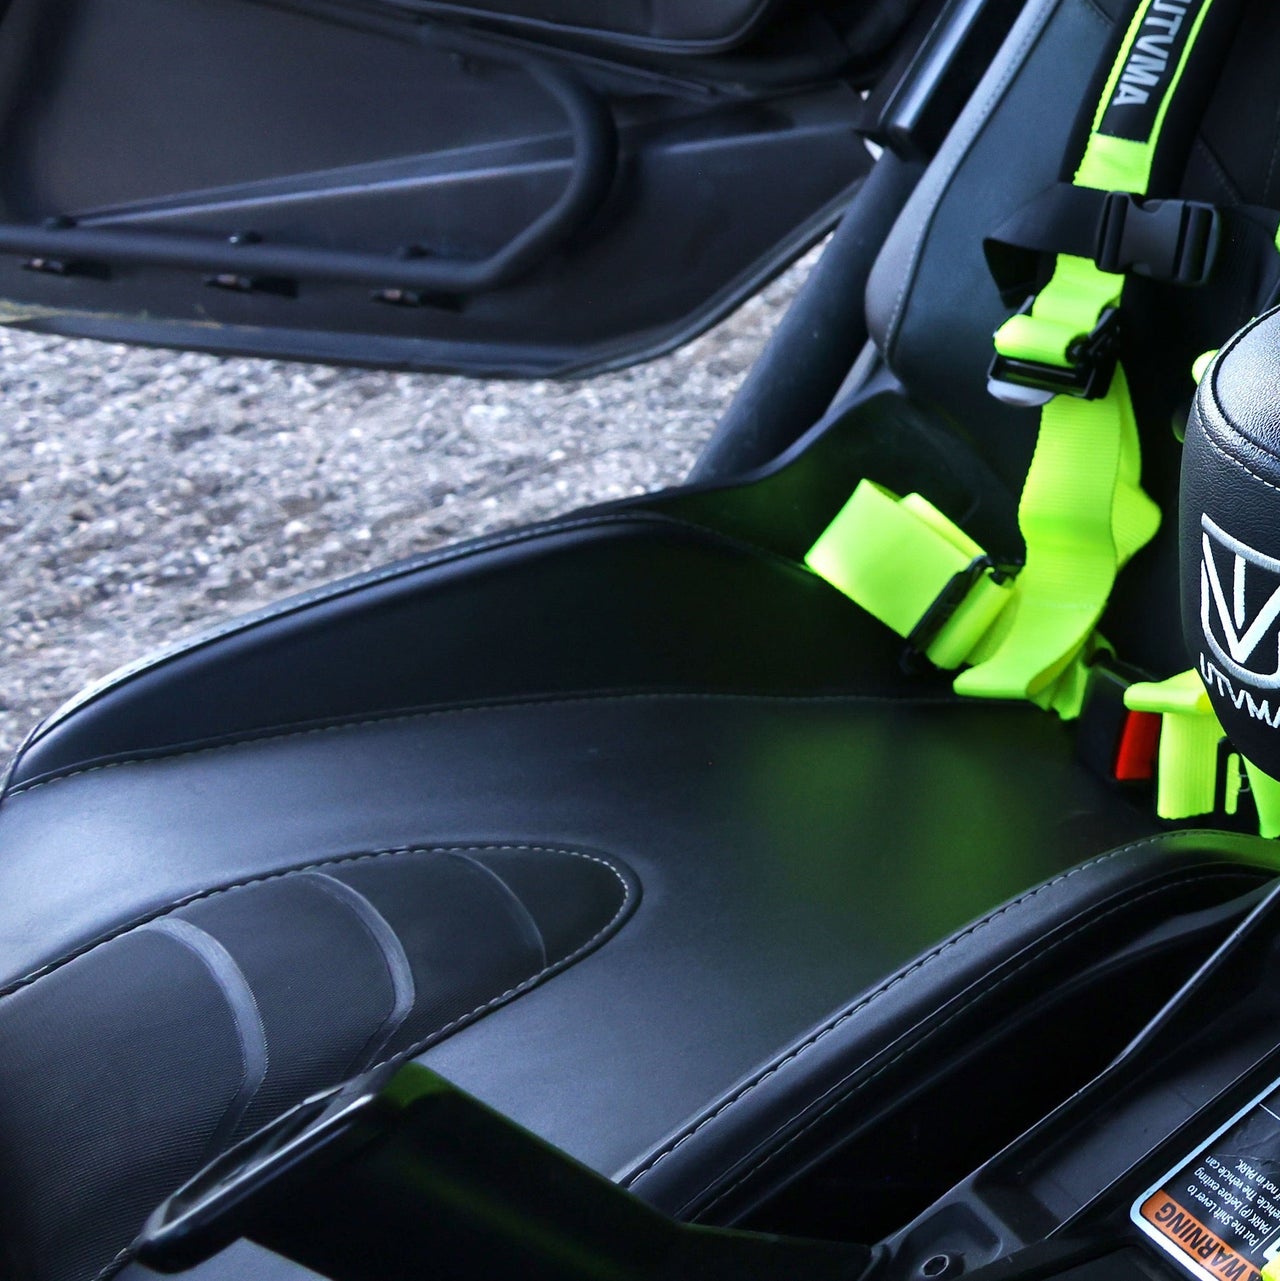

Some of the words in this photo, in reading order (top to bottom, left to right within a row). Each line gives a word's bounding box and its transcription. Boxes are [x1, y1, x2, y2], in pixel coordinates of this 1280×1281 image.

[1205, 1155, 1221, 1169] can
[1234, 1158, 1259, 1181] PARK.
[1193, 1166, 1220, 1191] exiting
[1217, 1165, 1245, 1192] vehicle
[1255, 1173, 1267, 1187] in
[1261, 1180, 1279, 1195] not
[1187, 1184, 1198, 1196] to
[1217, 1187, 1244, 1212] before
[1241, 1184, 1258, 1202] The
[1194, 1191, 1218, 1213] Lever
[1237, 1204, 1254, 1219] (P)
[1212, 1206, 1234, 1226] Shift
[1247, 1212, 1273, 1235] PARK
[1230, 1219, 1246, 1236] the
[1154, 1201, 1247, 1281] WARNING
[1242, 1230, 1260, 1247] Put
